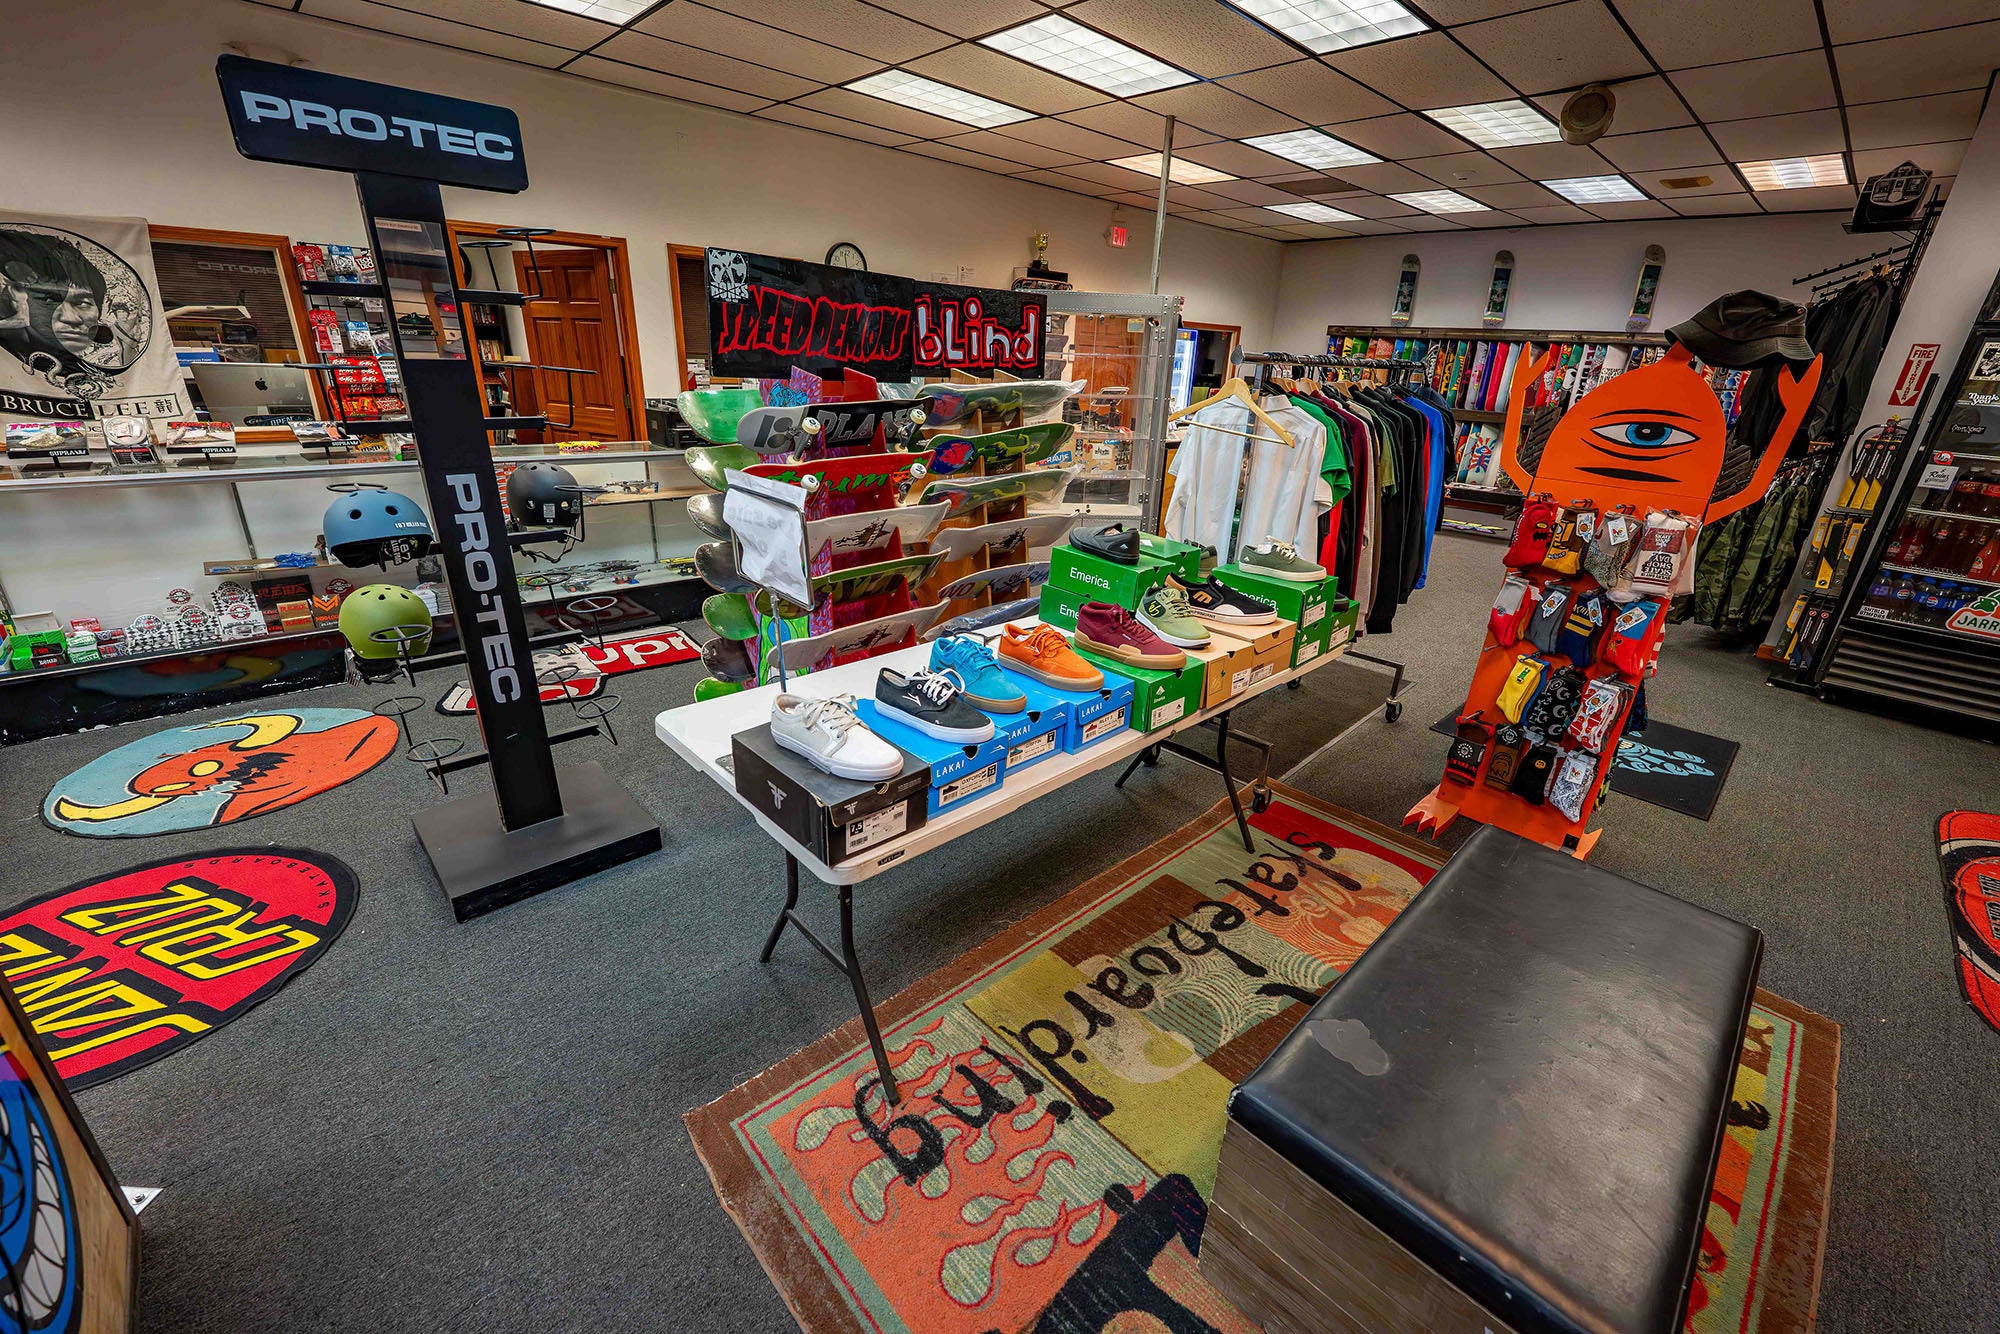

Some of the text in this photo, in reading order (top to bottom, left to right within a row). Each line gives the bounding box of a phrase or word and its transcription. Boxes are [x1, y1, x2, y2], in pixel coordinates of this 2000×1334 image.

[239, 90, 515, 162] PRO-TEC
[1112, 226, 1126, 246] EXIT
[710, 282, 749, 299] BONES
[718, 286, 911, 363] SPEED DEMONS
[1913, 350, 1934, 359] FIRE
[1969, 392, 2000, 402] Thank
[1971, 397, 1991, 406] you
[3, 395, 150, 417] BRUCE LEE
[1647, 561, 1671, 569] SHOP
[1654, 554, 1671, 562] DAY
[1069, 567, 1111, 590] Emerica.
[1643, 566, 1672, 576] SKATE
[445, 473, 521, 704] PRO-TEC
[1957, 614, 2000, 632] JARR
[1082, 703, 1103, 718] LAKAI
[1008, 725, 1031, 740] AKAI
[936, 760, 965, 777] LAKAI
[851, 823, 862, 832] 7.5
[61, 883, 320, 980] CRUZ
